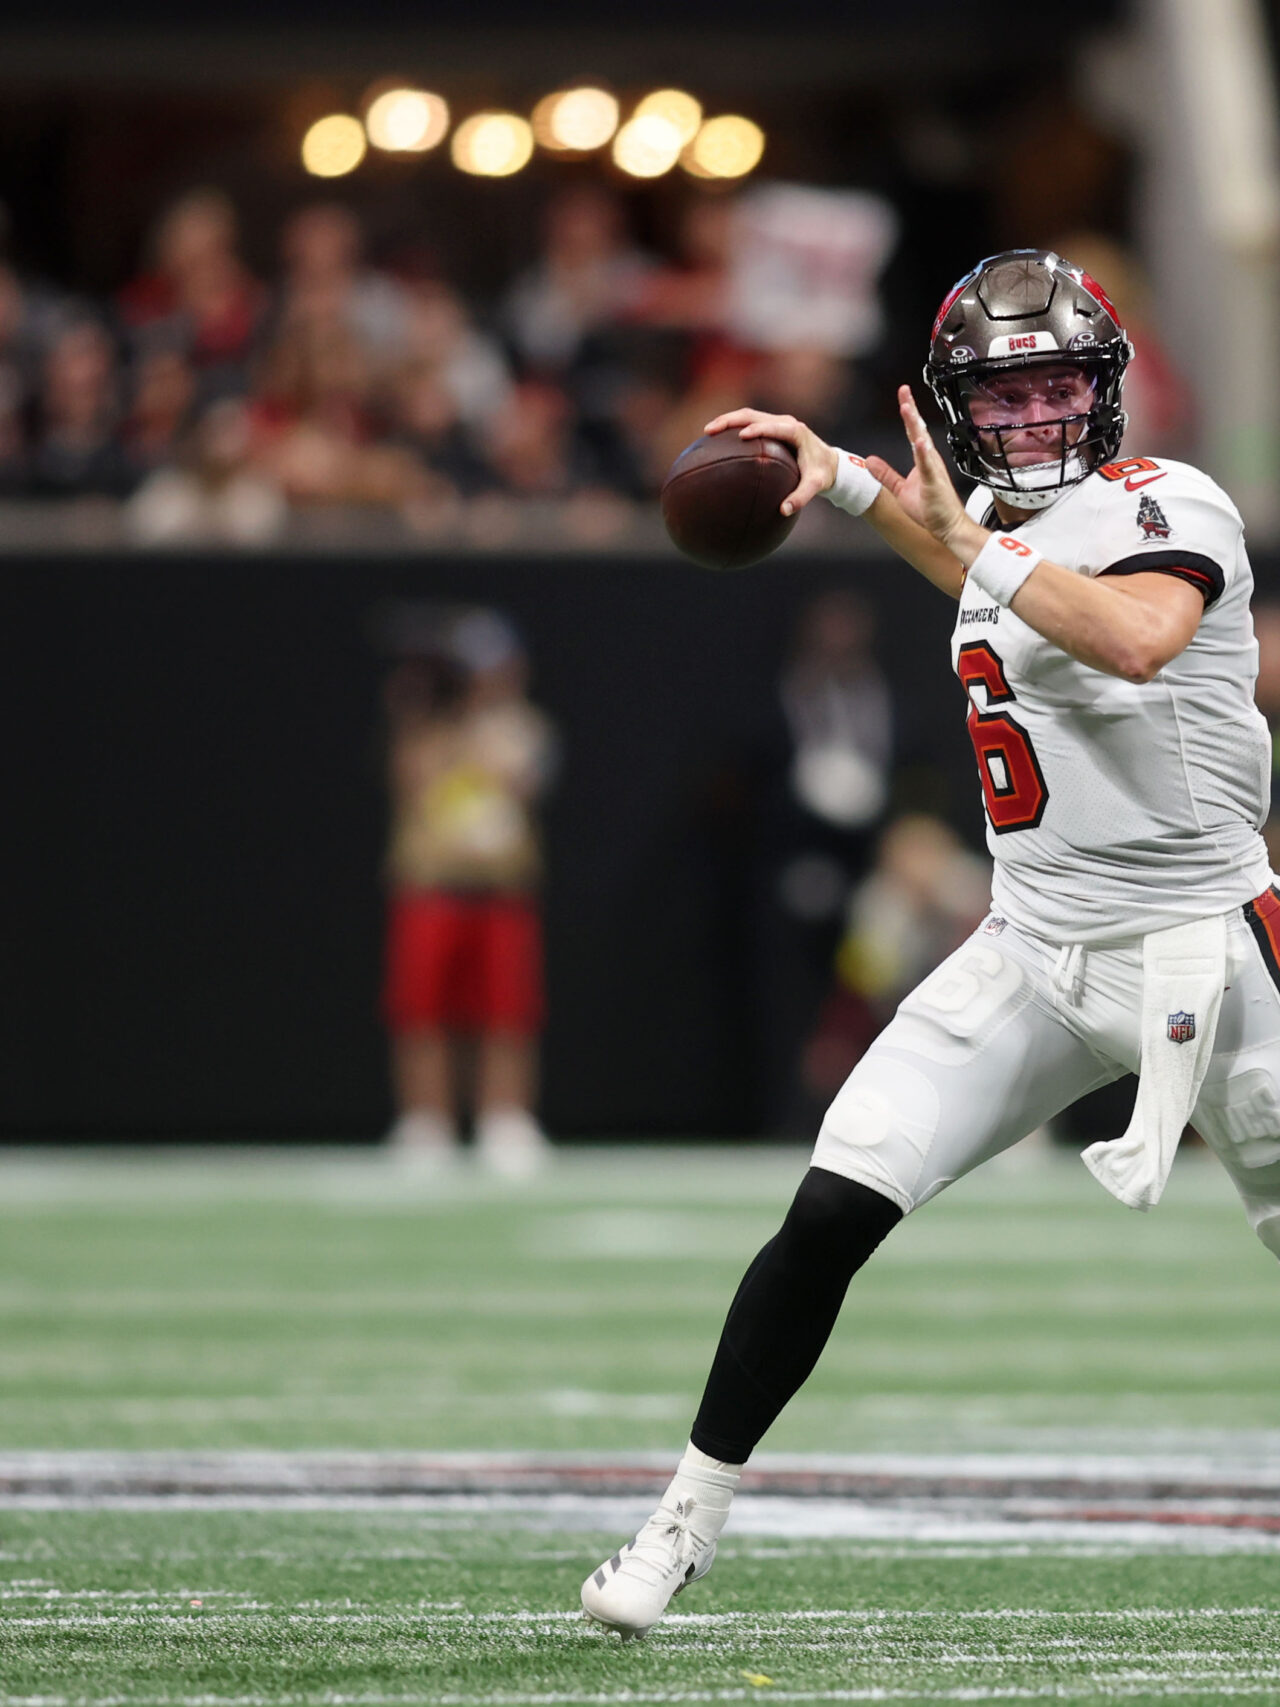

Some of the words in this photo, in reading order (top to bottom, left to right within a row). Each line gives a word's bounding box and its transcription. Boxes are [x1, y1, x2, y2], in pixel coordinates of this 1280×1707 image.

[1009, 335, 1036, 351] BUCS
[958, 639, 1050, 835] 6
[1170, 1025, 1193, 1040] NFL
